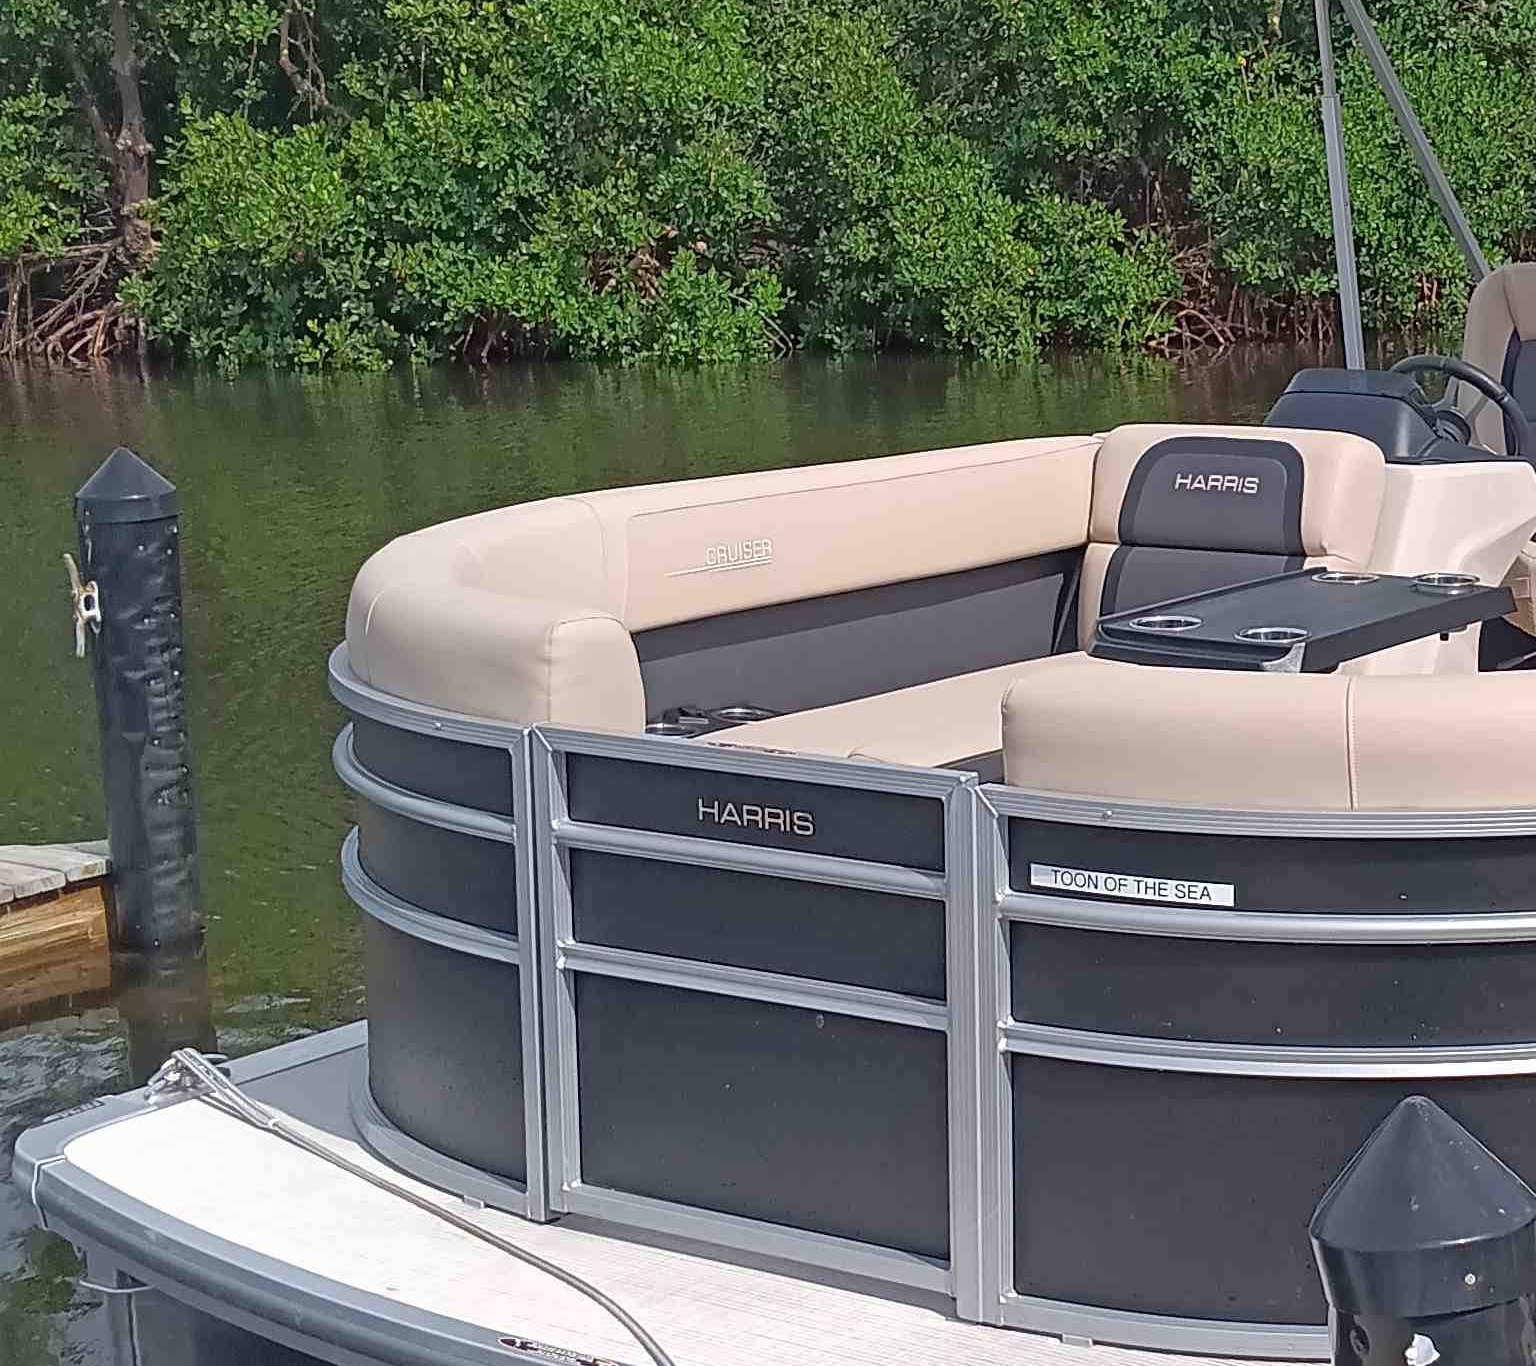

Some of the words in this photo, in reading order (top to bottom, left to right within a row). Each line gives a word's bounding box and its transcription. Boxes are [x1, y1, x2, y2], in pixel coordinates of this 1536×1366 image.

[1175, 473, 1260, 494] HARRIS
[706, 538, 773, 565] CRUISER
[698, 797, 815, 836] HARRIS
[1051, 869, 1098, 890] TOON
[1103, 876, 1129, 892] OF
[1132, 879, 1169, 897] THE
[1174, 883, 1212, 901] SEA
